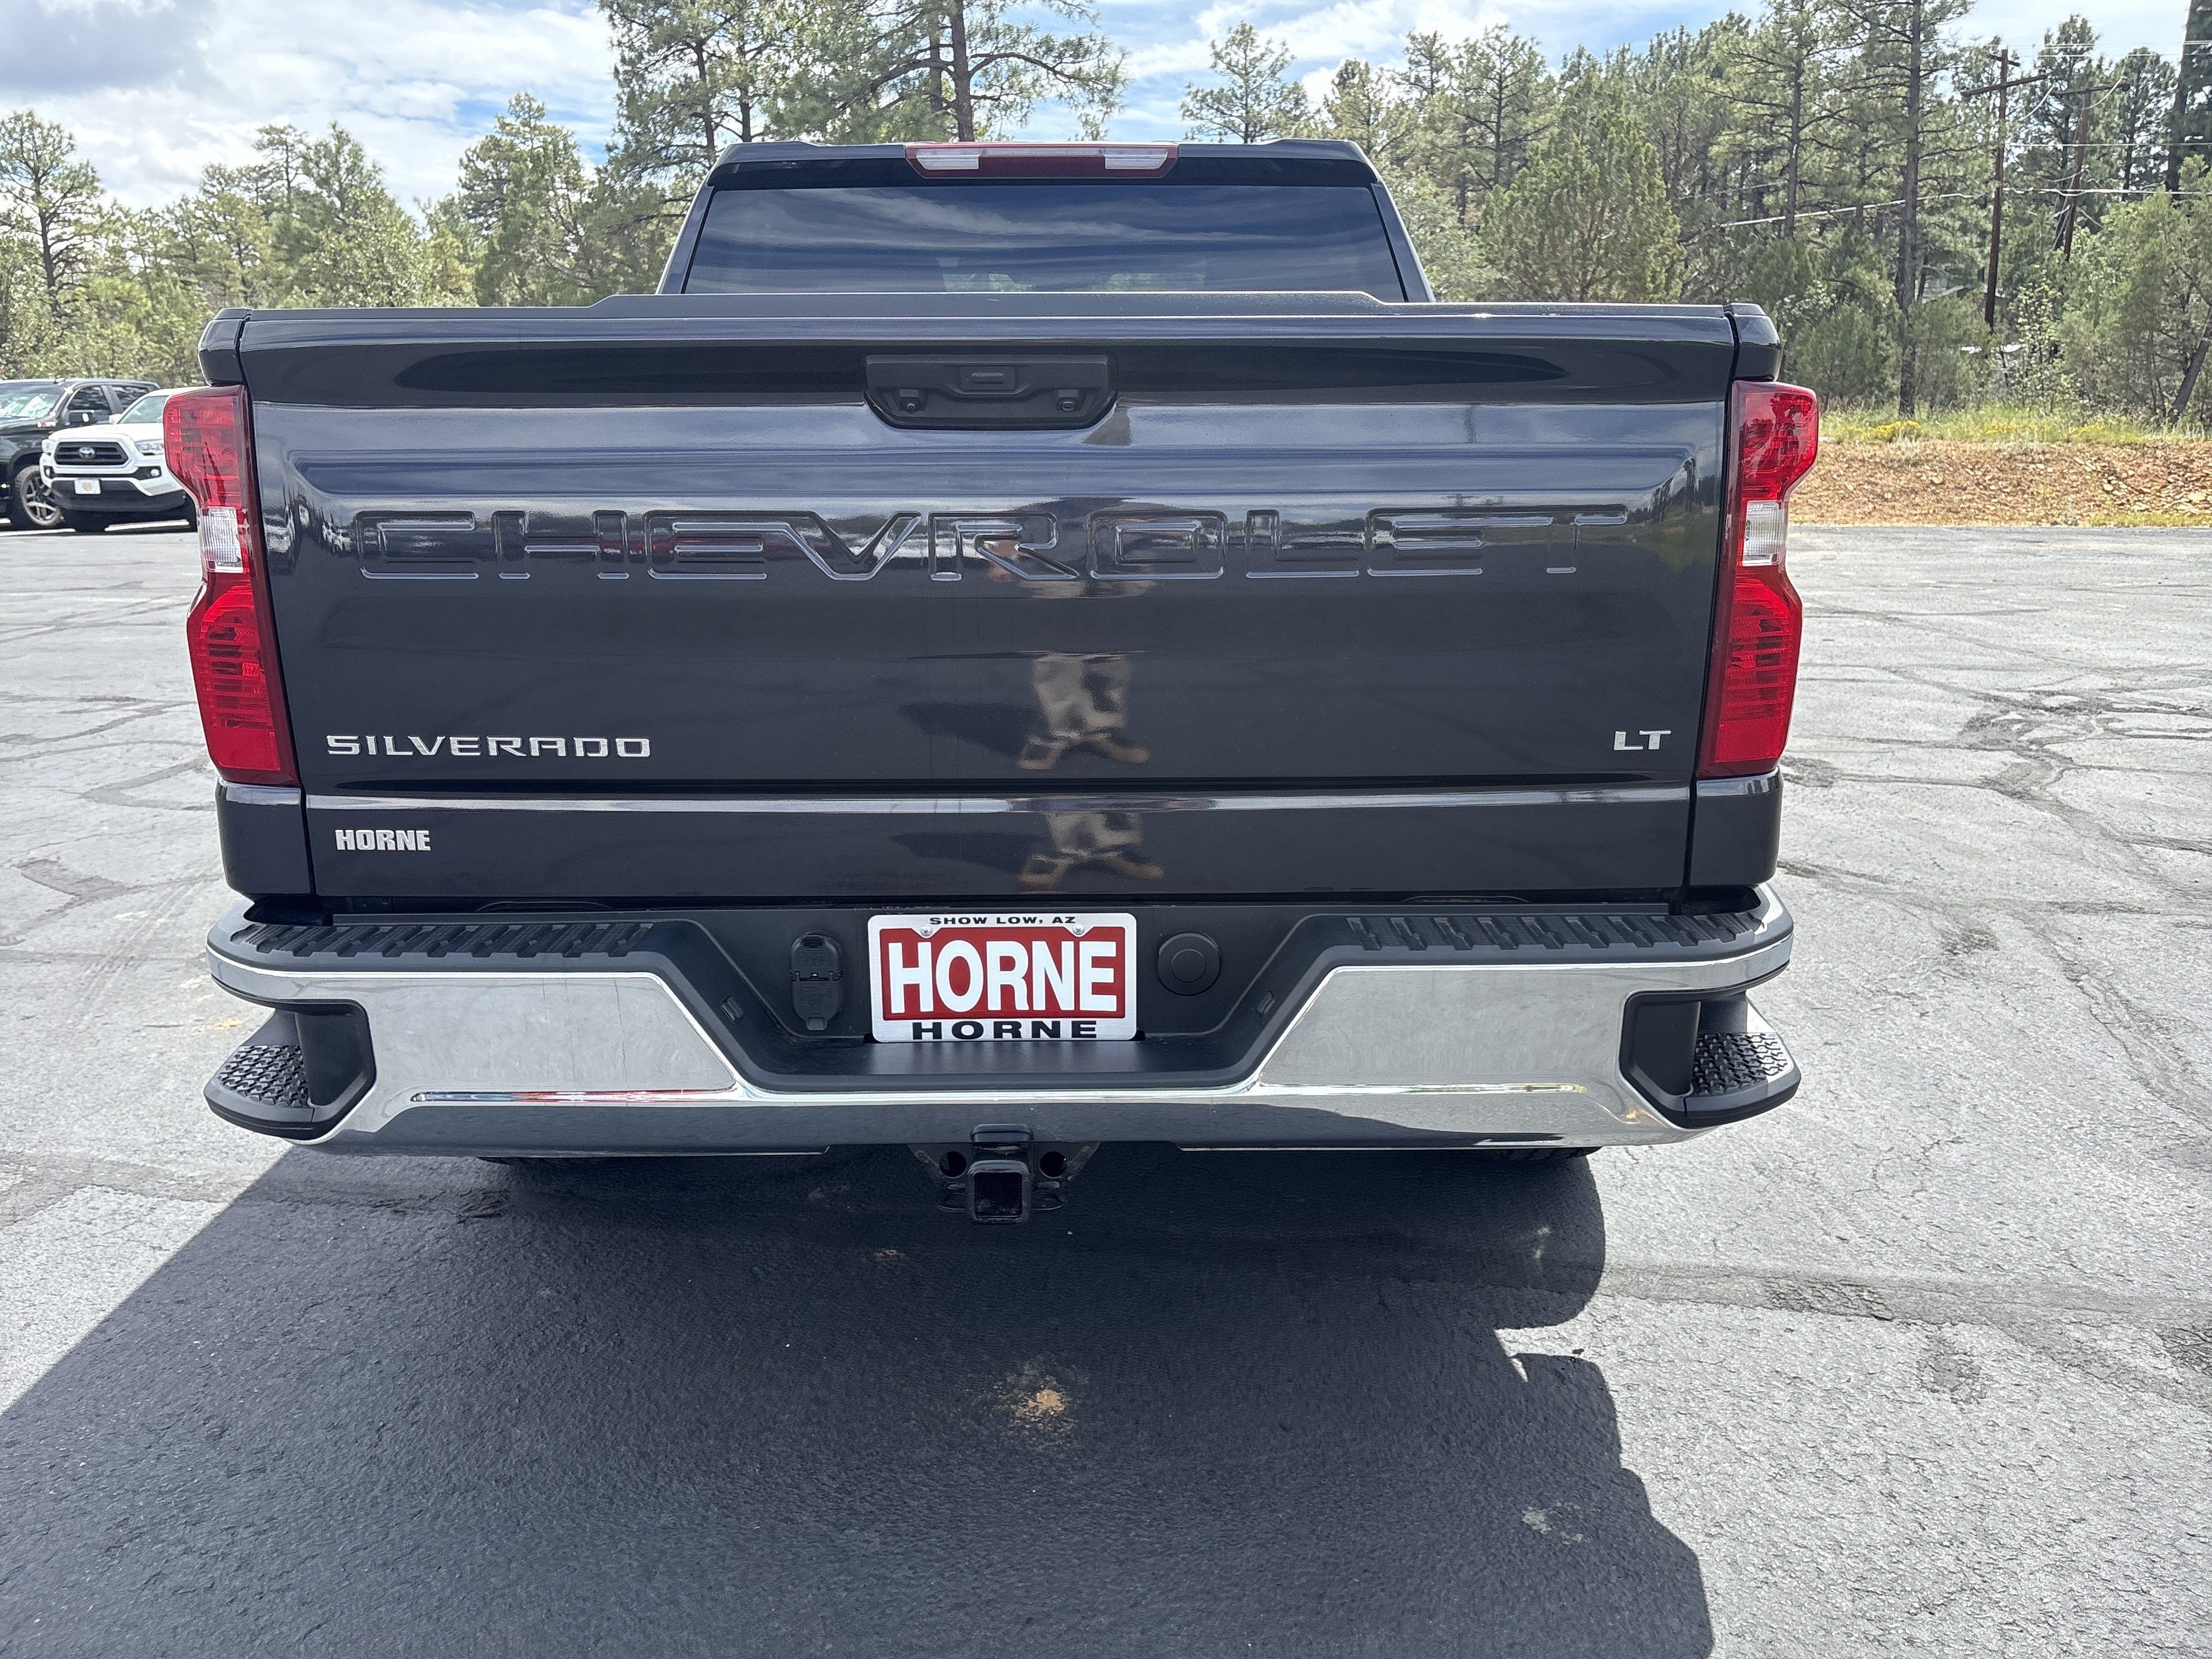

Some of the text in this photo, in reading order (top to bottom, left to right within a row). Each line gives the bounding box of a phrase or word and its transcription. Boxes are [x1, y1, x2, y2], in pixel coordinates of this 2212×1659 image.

[354, 504, 1628, 582] CHEVROLET
[326, 734, 652, 758] SILVERADO
[1613, 730, 1672, 751] LT
[335, 830, 431, 851] HORNE
[929, 916, 1077, 925] SHOW LOW, AZ
[888, 940, 1117, 1013] HORNE
[912, 1020, 1097, 1040] HORNE
